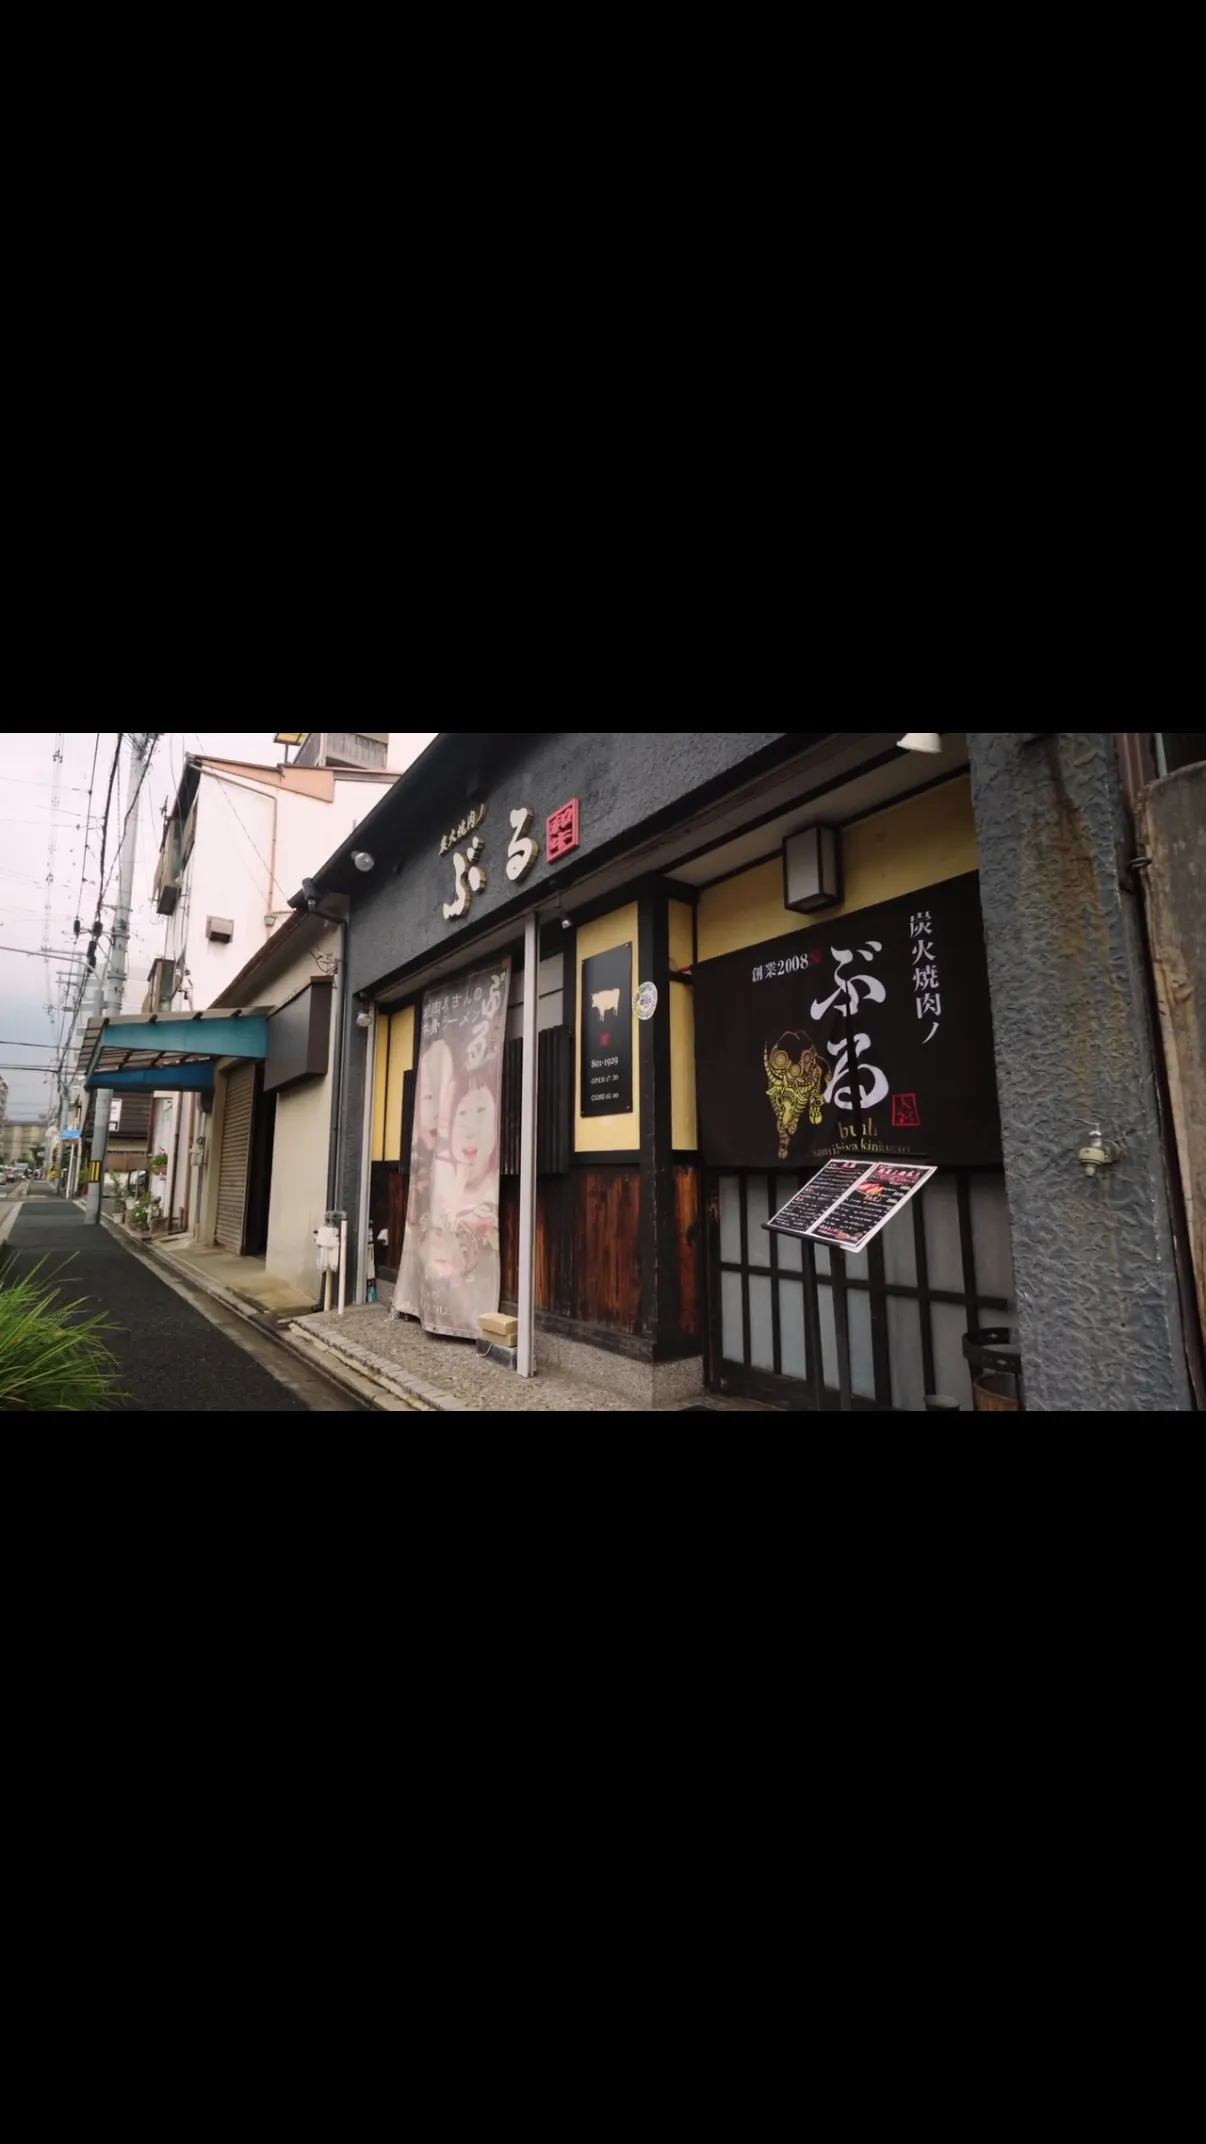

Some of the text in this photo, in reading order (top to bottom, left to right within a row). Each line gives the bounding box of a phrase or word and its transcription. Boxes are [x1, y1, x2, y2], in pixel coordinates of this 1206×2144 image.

[443, 807, 538, 920] ぶる
[752, 953, 809, 983] 創業2008
[810, 940, 889, 1111] ぶる
[910, 910, 943, 1045] 炭火焼肉ノ
